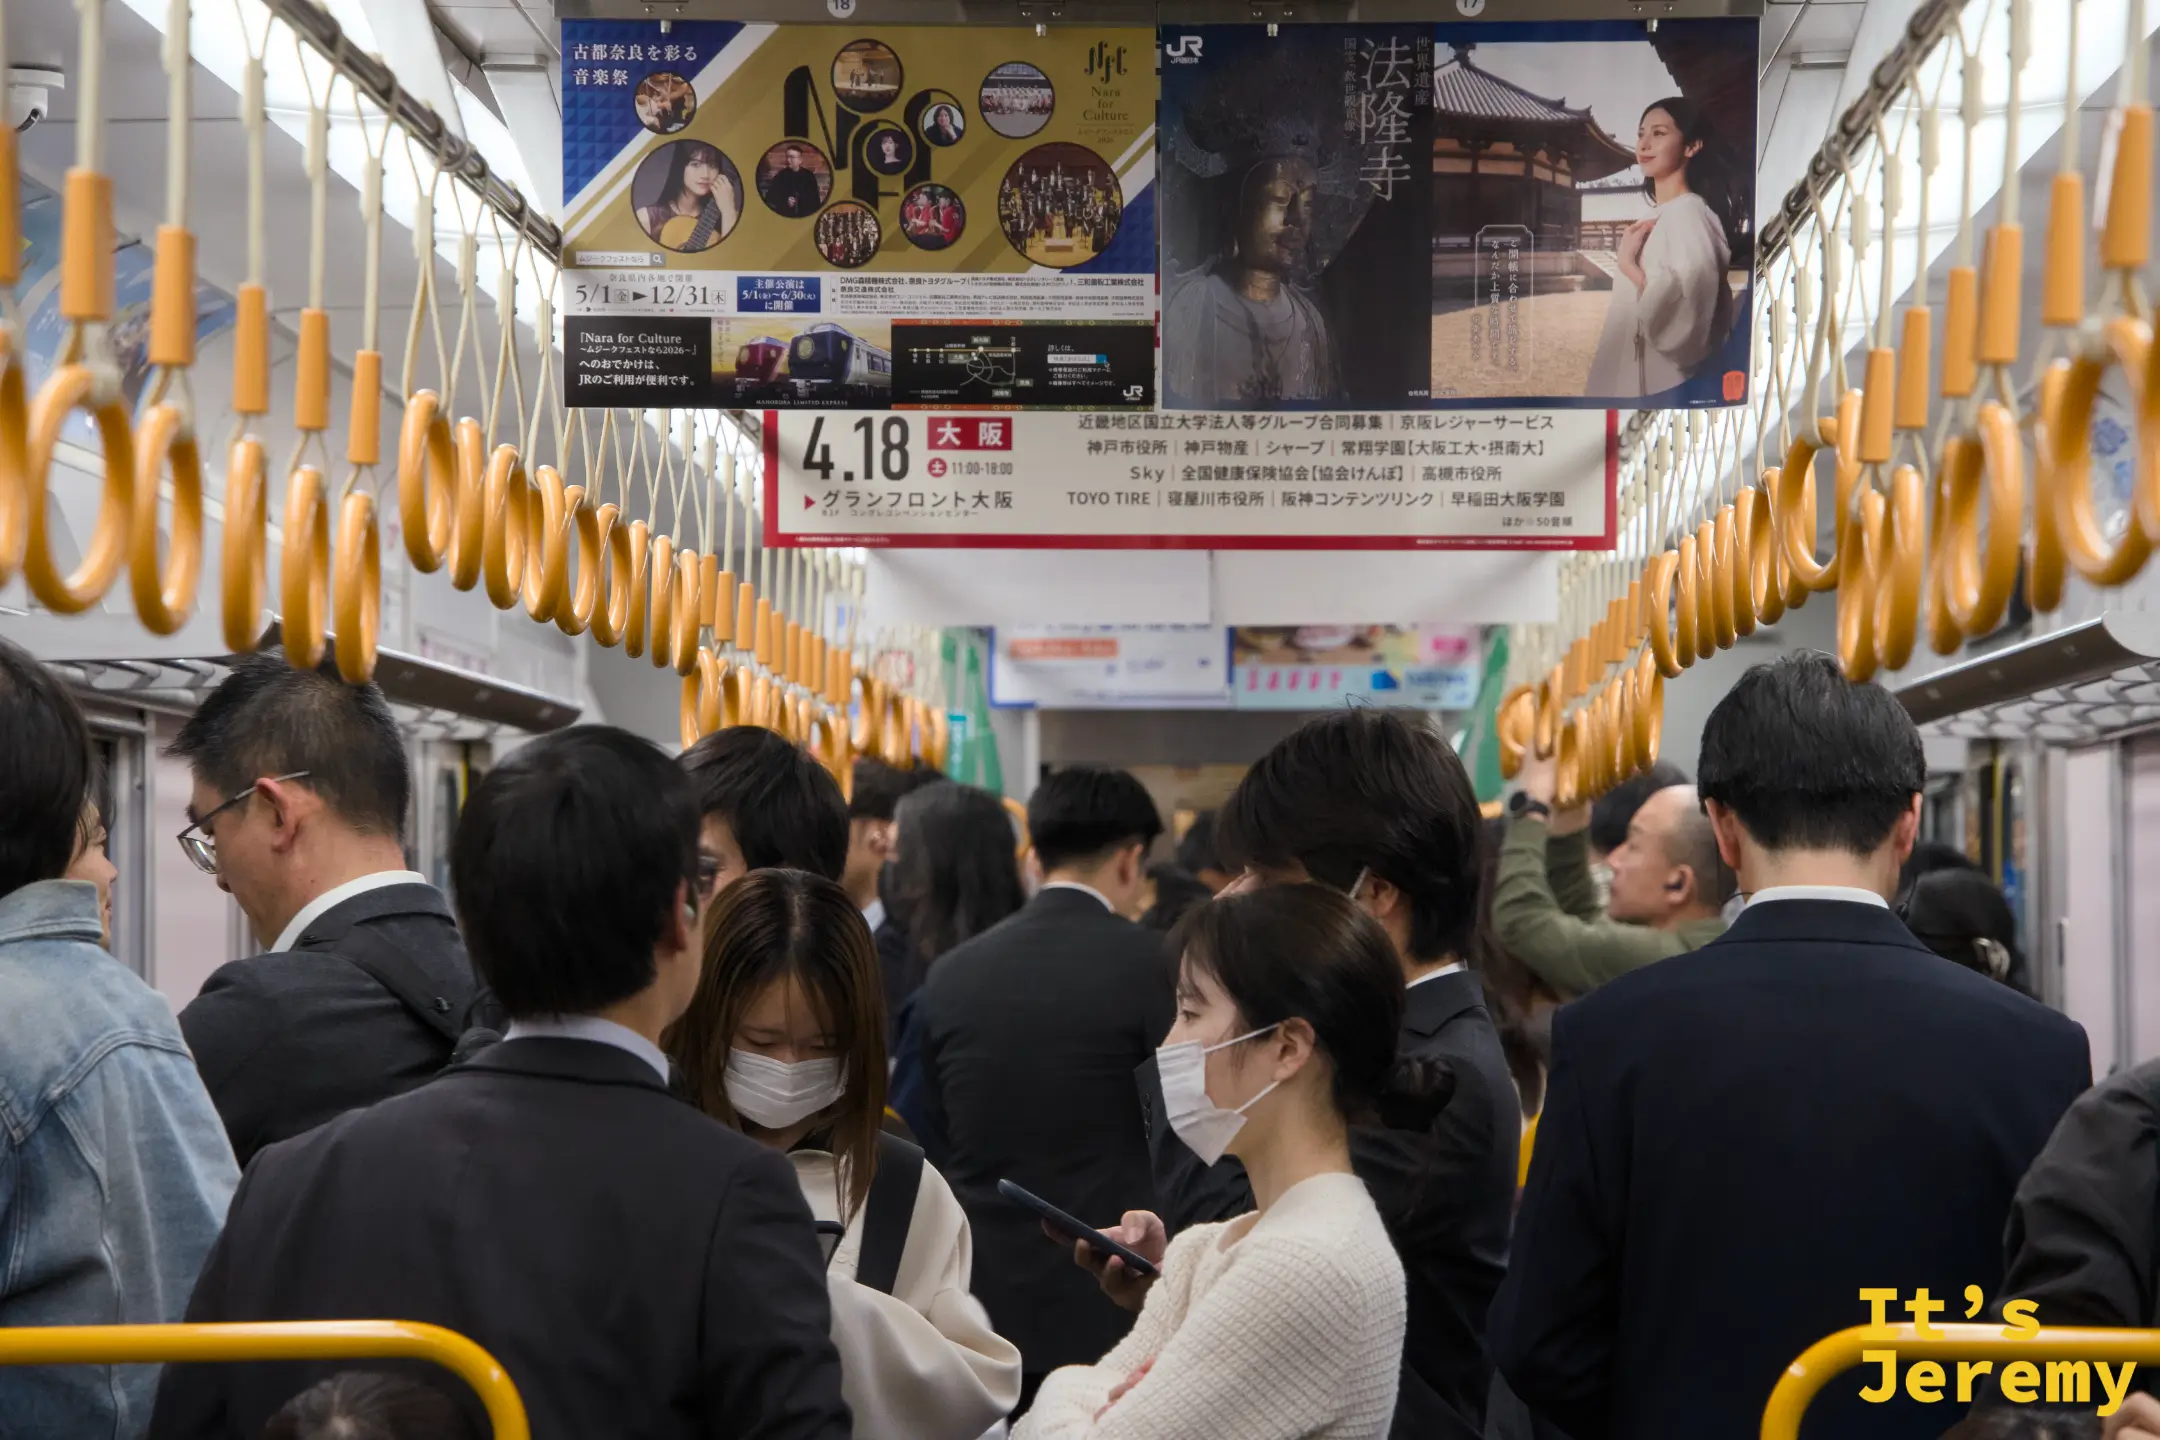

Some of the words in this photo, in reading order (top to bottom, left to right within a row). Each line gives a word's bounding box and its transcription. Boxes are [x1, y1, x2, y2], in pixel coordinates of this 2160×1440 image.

[572, 43, 698, 62] 古都奈良を彩る
[1166, 36, 1203, 57] JR
[572, 69, 629, 86] 音楽祭
[1413, 35, 1430, 106] 世界遺産
[1091, 86, 1121, 97] Nara
[1097, 98, 1114, 109] for
[1083, 109, 1129, 121] Culture
[1360, 36, 1413, 202] 法隆寺
[764, 301, 794, 311] に開催
[618, 332, 635, 344] for
[638, 332, 682, 344] Culture
[579, 359, 661, 370] へのおでかけは、
[578, 374, 696, 386] JRのご利用が便利です。
[1122, 385, 1144, 397] JR
[1079, 414, 1383, 430] 近畿地区国立大学法人等グループ合同募集
[1399, 414, 1554, 430] 京阪レジャーサービス
[937, 421, 1003, 446] 大阪
[803, 416, 910, 482] 4.18
[1087, 440, 1167, 456] 神戸市役所
[1184, 440, 1249, 456] 神戸物産
[1266, 440, 1325, 456] シャープ
[952, 462, 1013, 475] 11:00-18:00
[1130, 466, 1165, 483] Sky
[1421, 465, 1503, 481] 高槻市役所
[823, 490, 1013, 509] グランフロント大阪
[1067, 491, 1109, 505] TOYO
[1116, 491, 1151, 505] TIRE
[1168, 490, 1265, 507] 寝屋川市役所
[1281, 491, 1433, 507] 阪神コンテンツリンク
[1451, 491, 1566, 507] 早稲田大阪学園
